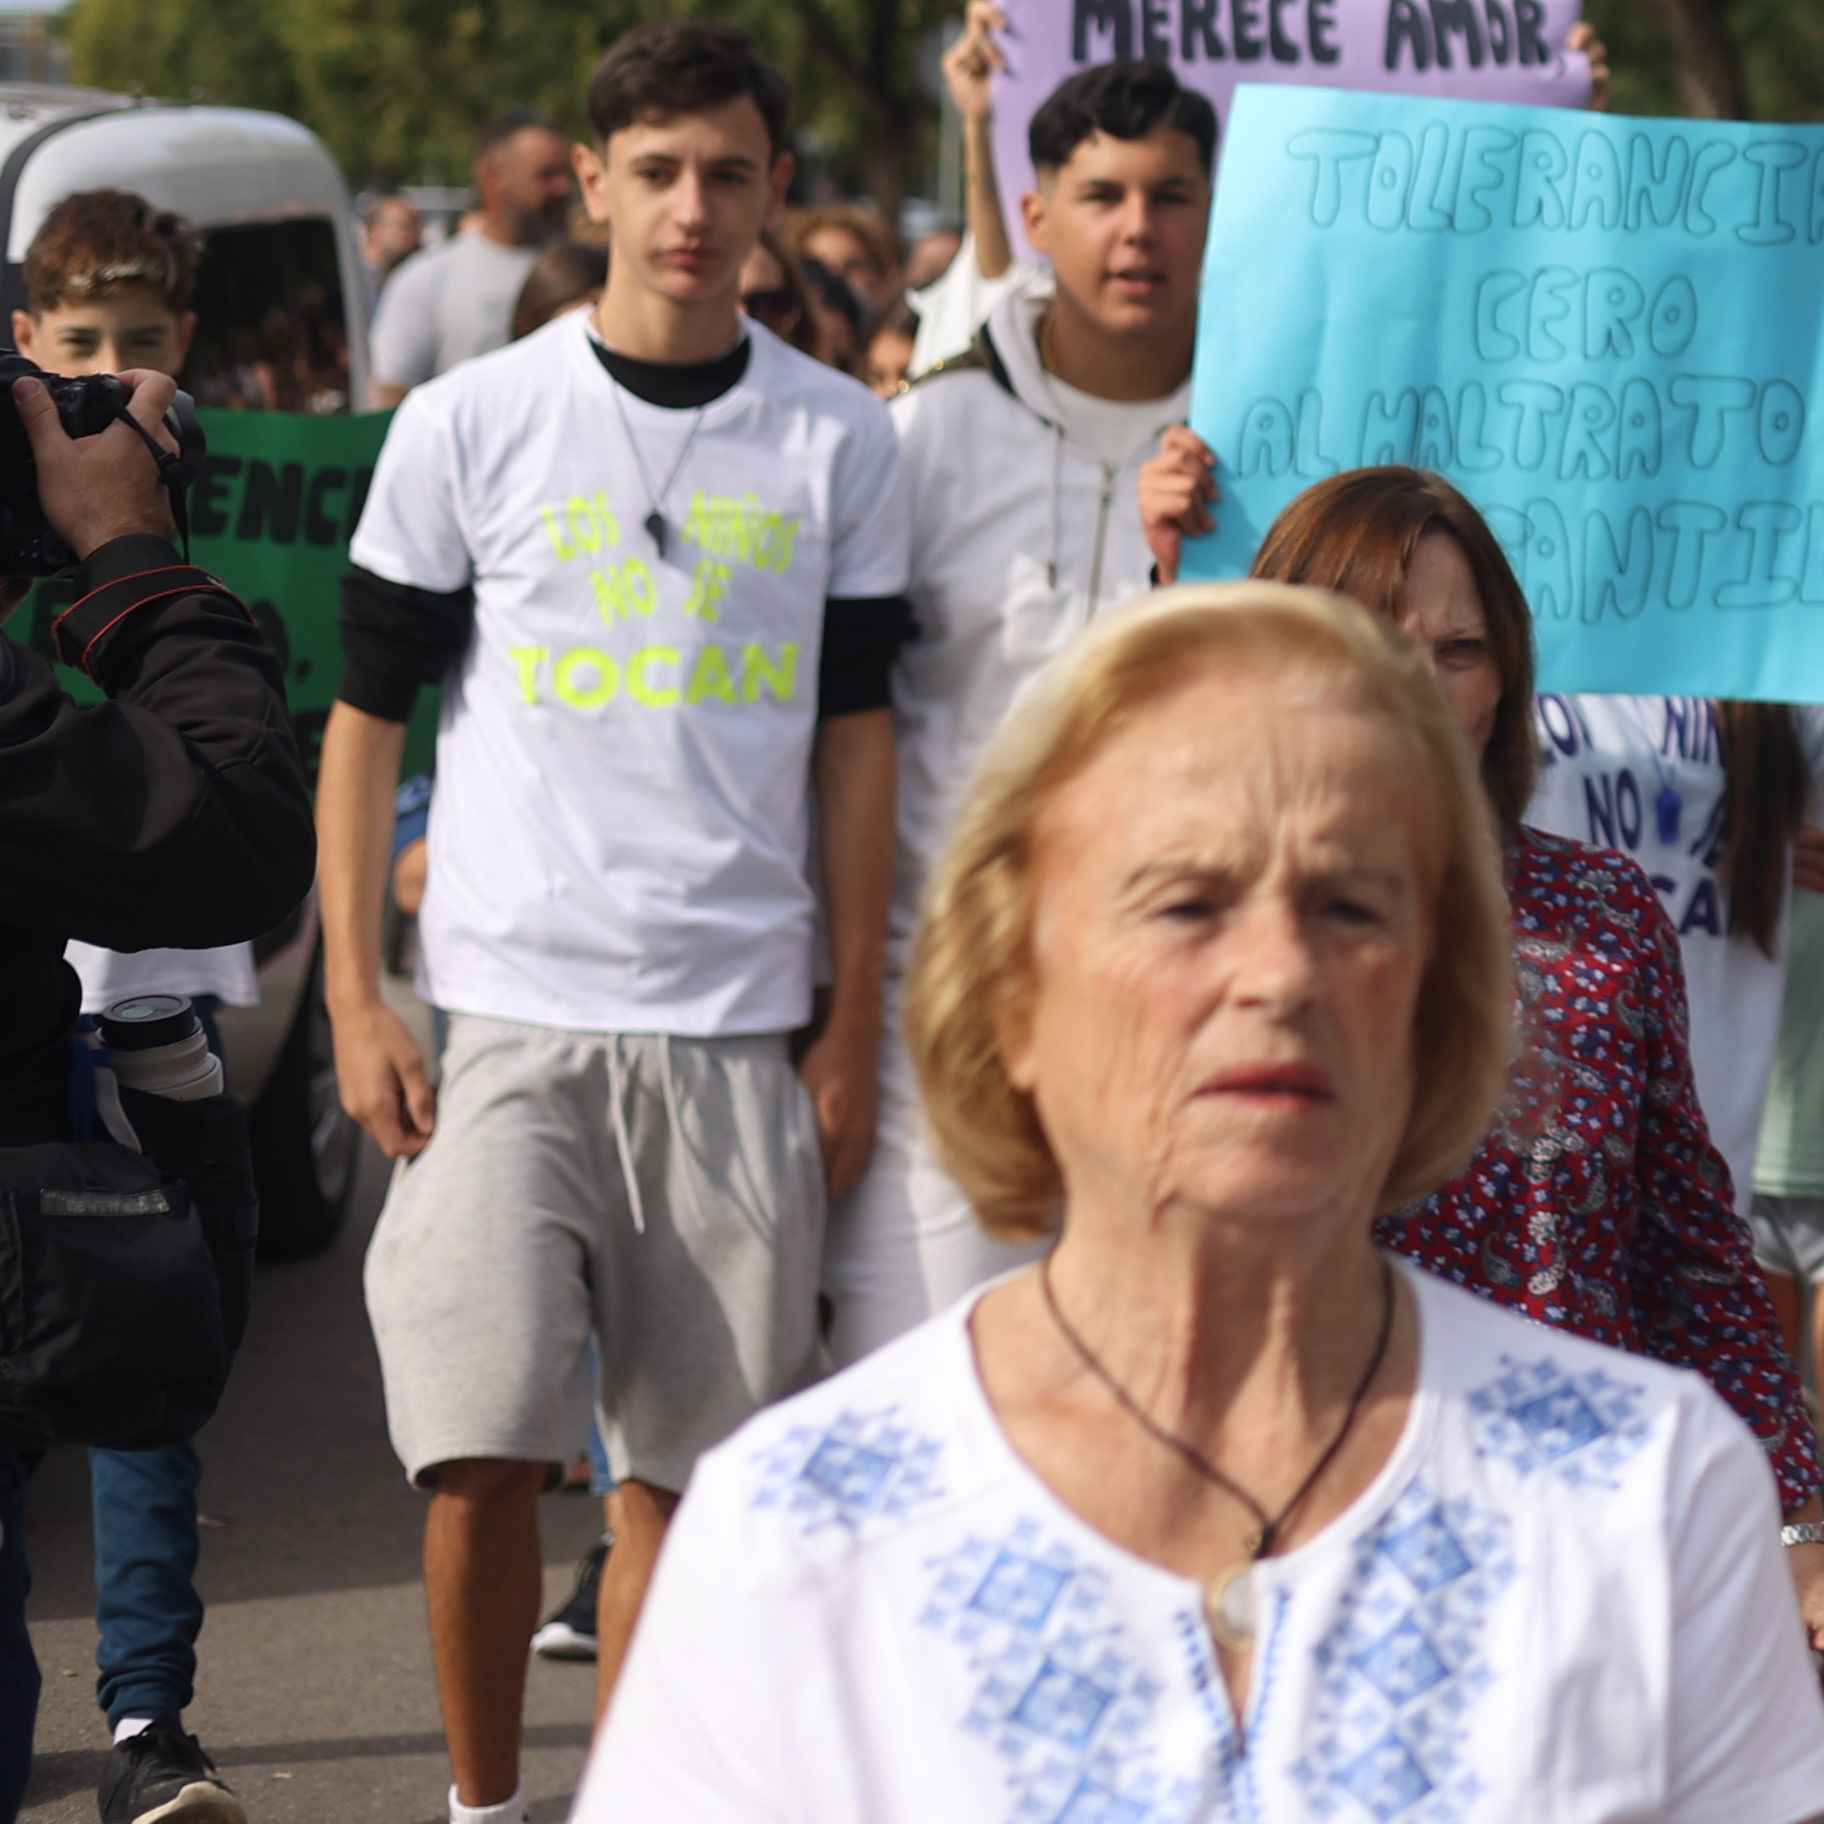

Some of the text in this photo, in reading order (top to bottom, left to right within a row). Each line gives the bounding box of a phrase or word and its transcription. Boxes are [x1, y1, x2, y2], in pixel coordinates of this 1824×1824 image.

[1472, 264, 1699, 366] CERO
[1362, 372, 1807, 481] MALTRATO
[588, 555, 660, 633] NO
[507, 642, 803, 711] TOCAN
[1583, 768, 1642, 852] NO
